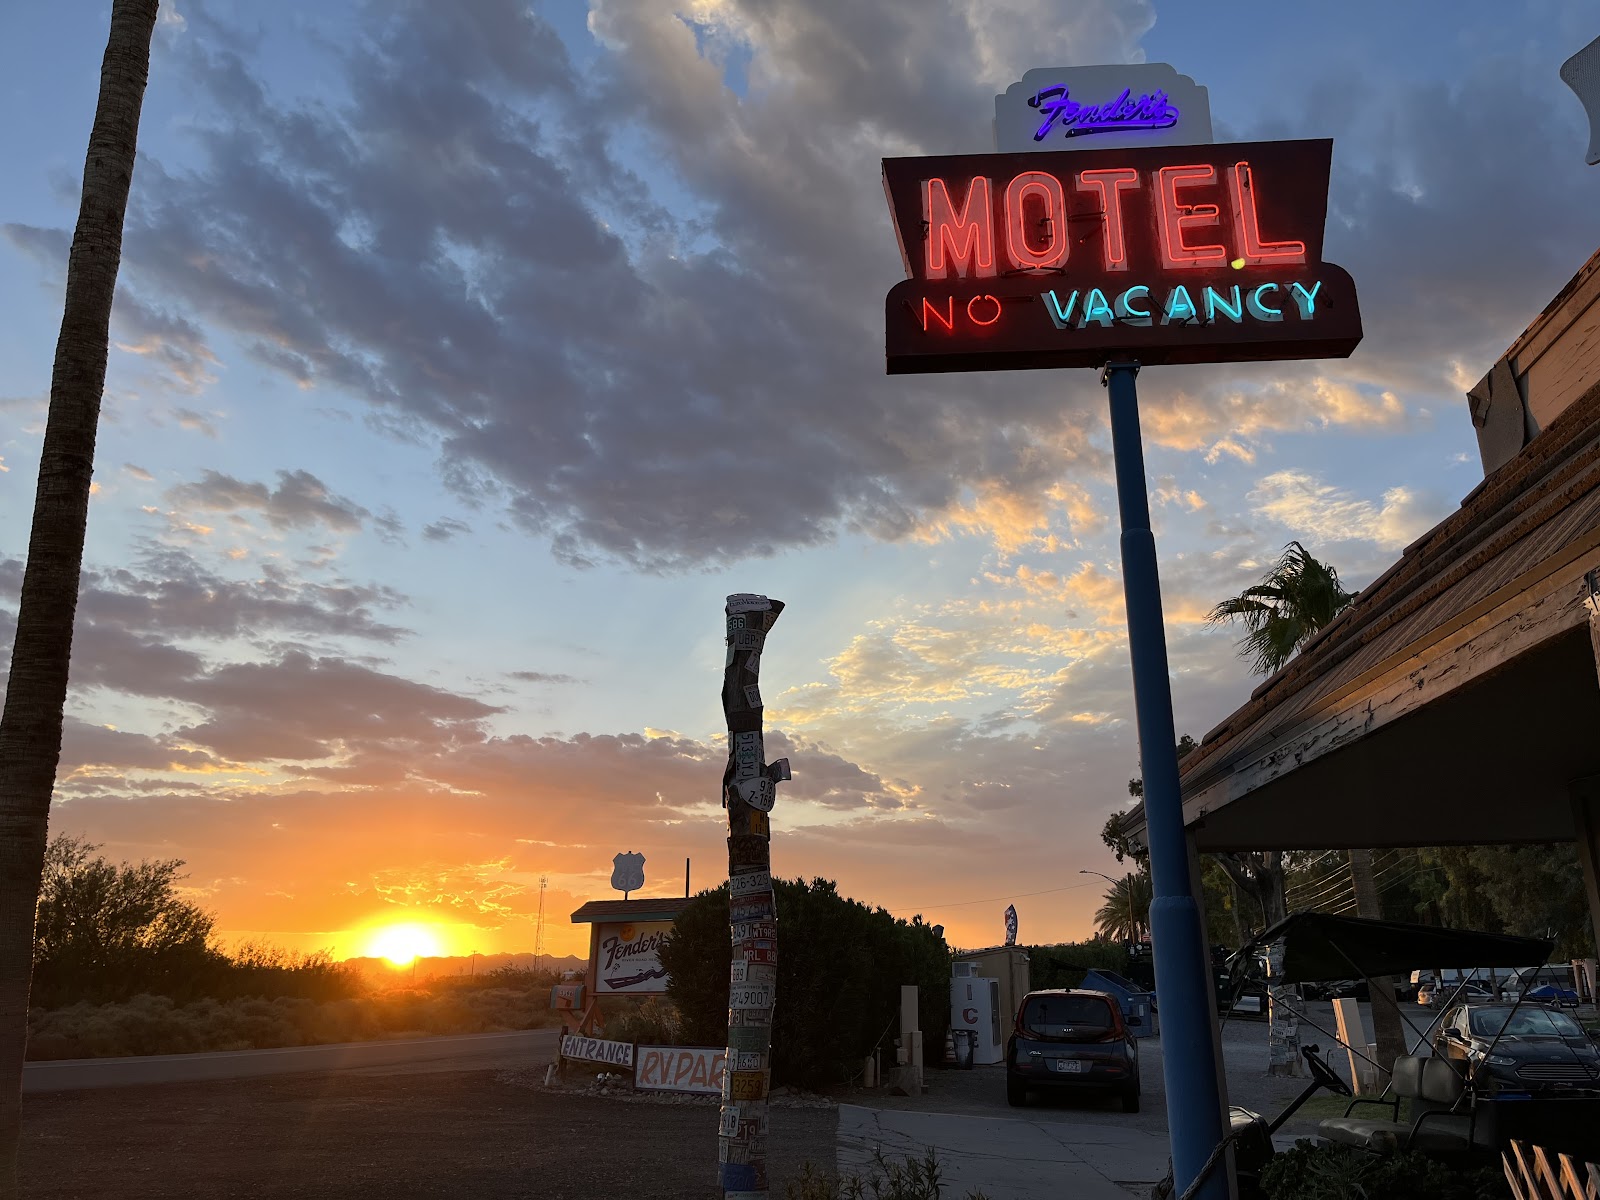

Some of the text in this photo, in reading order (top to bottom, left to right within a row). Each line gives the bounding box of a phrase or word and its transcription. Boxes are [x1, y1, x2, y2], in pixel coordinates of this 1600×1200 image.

[1027, 83, 1178, 141] Fender's
[921, 161, 1306, 279] MOTEL
[922, 281, 1322, 331] NO VACANCY
[602, 930, 669, 971] Fender's
[564, 1036, 632, 1064] ENTRANCE
[734, 1078, 761, 1094] 3259
